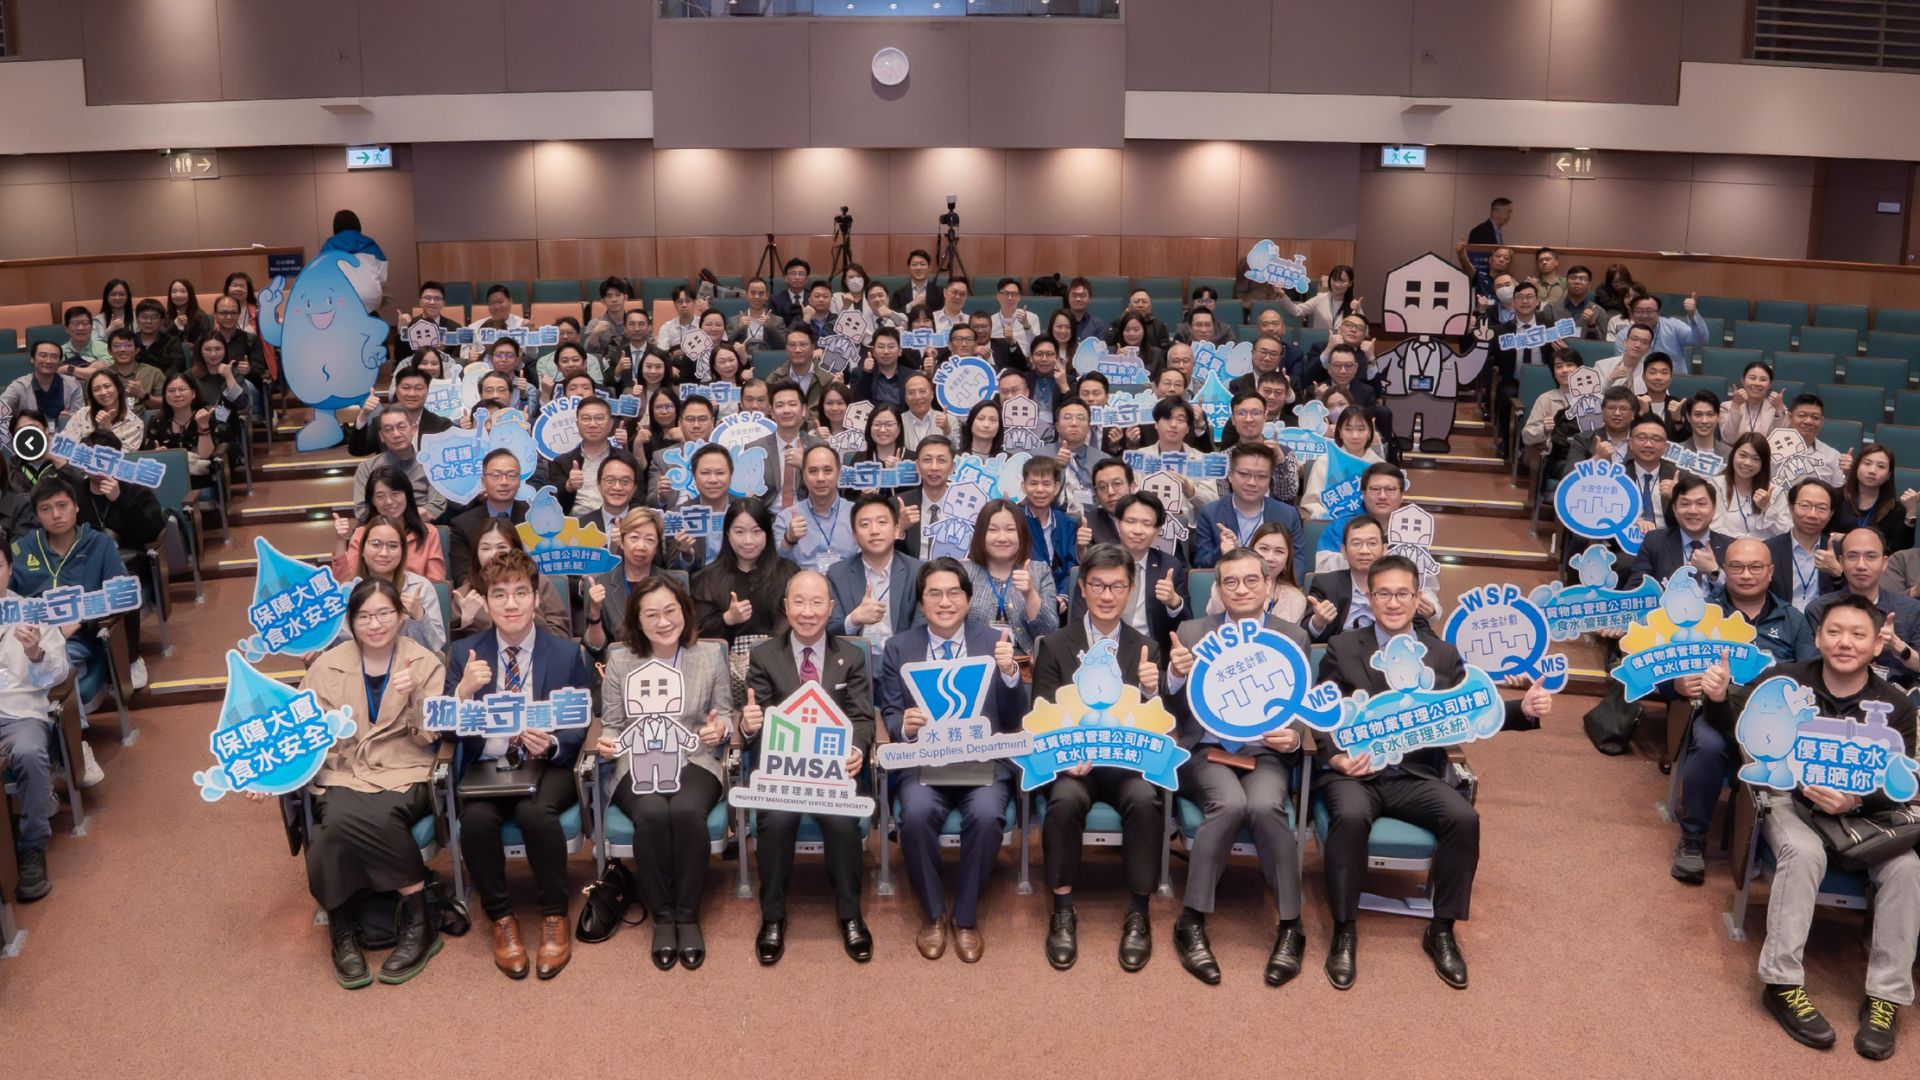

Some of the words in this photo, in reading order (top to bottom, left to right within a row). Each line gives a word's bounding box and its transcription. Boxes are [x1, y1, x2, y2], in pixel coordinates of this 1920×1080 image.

[934, 356, 960, 384] WSP
[725, 413, 762, 427] WSP
[1577, 462, 1623, 478] WSP
[1461, 587, 1518, 613] WSP
[1541, 596, 1658, 620] 質物業管理公司計劃
[265, 595, 346, 650] 食水安全
[1195, 621, 1258, 663] WSP
[1215, 650, 1268, 683] 水安全計劃
[427, 691, 588, 734] 物業守護者
[1339, 689, 1490, 746] 優質物業管理公司計劃
[926, 725, 984, 744] 水務署
[1034, 730, 1164, 753] 優質物業管理公司計劃
[229, 725, 331, 786] 食水安全
[885, 750, 916, 761] Water
[919, 747, 964, 760] Supplies
[966, 738, 1028, 755] Department
[1798, 739, 1885, 767] 優質食水
[766, 754, 843, 781] PMSA
[735, 794, 765, 803] PROPERTY
[765, 796, 807, 806] MANAGEMENT
[808, 800, 834, 808] SERVICES
[835, 802, 869, 810] AUTHORITY
